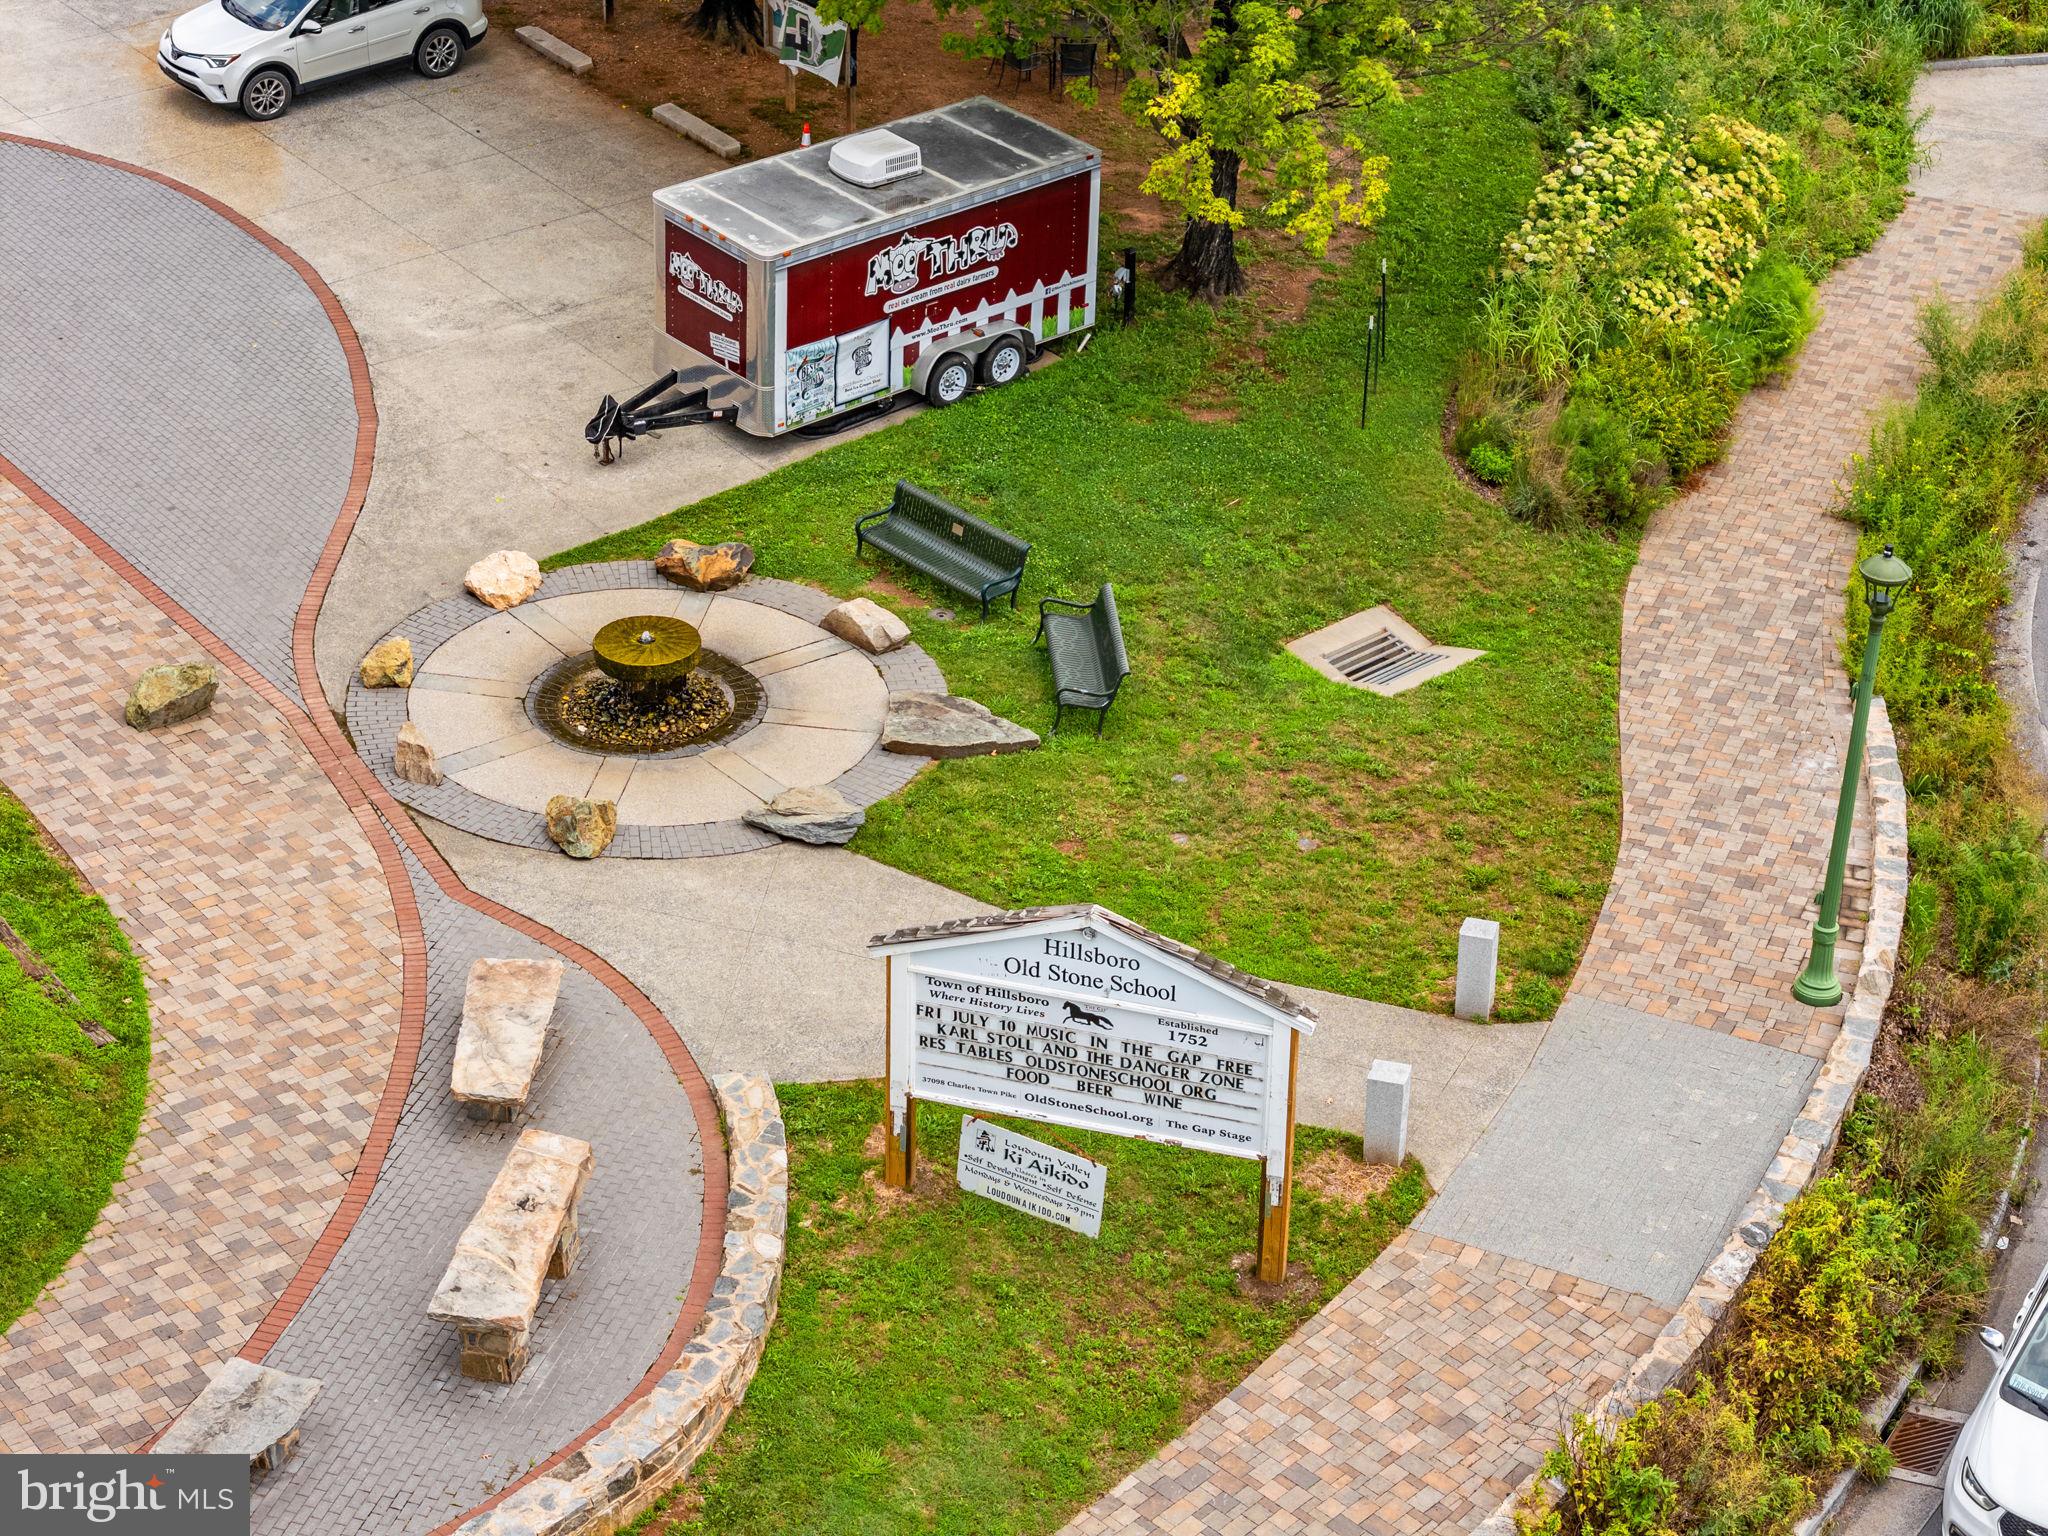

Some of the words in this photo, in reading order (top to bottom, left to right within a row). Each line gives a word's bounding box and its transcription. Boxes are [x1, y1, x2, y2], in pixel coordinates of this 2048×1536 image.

[926, 222, 1018, 279] THRU
[888, 300, 900, 310] real
[901, 297, 910, 306] ice
[910, 291, 928, 303] cream
[929, 286, 943, 297] from
[944, 283, 955, 293] real
[956, 276, 971, 288] dairy
[972, 269, 995, 282] farmers
[911, 316, 968, 340] www.MooThru.com
[1043, 938, 1141, 971] Hillsboro
[925, 976, 962, 990] Town
[967, 984, 982, 994] of
[985, 986, 1050, 1007] Hillsboro
[1004, 957, 1040, 978] Old
[1048, 964, 1104, 989] Stone
[1110, 975, 1177, 1002] School
[929, 989, 966, 1003] Where
[969, 996, 1013, 1014] History
[1016, 1006, 1046, 1018] Lives
[916, 1004, 941, 1019] FRI
[952, 1010, 989, 1027] JULY
[1000, 1020, 1016, 1032] 10
[1027, 1025, 1076, 1044] MUSIC
[1090, 1035, 1108, 1050] IN
[1121, 1041, 1153, 1058] THE
[1167, 1050, 1202, 1066] GAP
[1217, 1059, 1253, 1076] FREE
[1158, 1018, 1219, 1036] Established
[1168, 1030, 1208, 1047] 1752
[919, 1035, 946, 1050] RES
[956, 1041, 1013, 1063] TABLES
[1025, 1055, 1173, 1093] OLDSTONESCHOOL
[1181, 1084, 1217, 1101] ORG
[937, 1023, 978, 1041] KARL
[987, 1032, 1034, 1051] STOLL
[1042, 1043, 1078, 1059] AND
[1086, 1050, 1113, 1066] THE
[1120, 1057, 1190, 1080] DANGER
[1200, 1071, 1244, 1090] ZONE
[921, 1076, 945, 1086] 37098
[947, 1080, 976, 1091] Charles
[977, 1086, 998, 1096] Town
[1000, 1090, 1017, 1099] Pike
[1006, 1067, 1050, 1085] FOOD
[1077, 1080, 1113, 1097] BEER
[1144, 1092, 1183, 1110] WINE
[1024, 1092, 1154, 1126] OldStoneSchool.org
[1166, 1119, 1188, 1131] The
[1192, 1124, 1216, 1136] Gap
[1219, 1129, 1252, 1143] Stage
[1004, 1138, 1052, 1162] Loudoun
[1057, 1158, 1091, 1179] Valley
[1004, 1148, 1023, 1165] Ki
[1028, 1159, 1089, 1190] Aikido
[965, 1164, 1001, 1184] Mondays
[1004, 1179, 1011, 1187] &
[1013, 1182, 1063, 1208] Wednesdays
[1066, 1202, 1080, 1214] 7-9
[1080, 1209, 1096, 1220] pm
[986, 1185, 1071, 1225] LOUDOUNAIKIDO.COM
[987, 1161, 1038, 1186] Development
[1066, 1190, 1097, 1208] Defense
